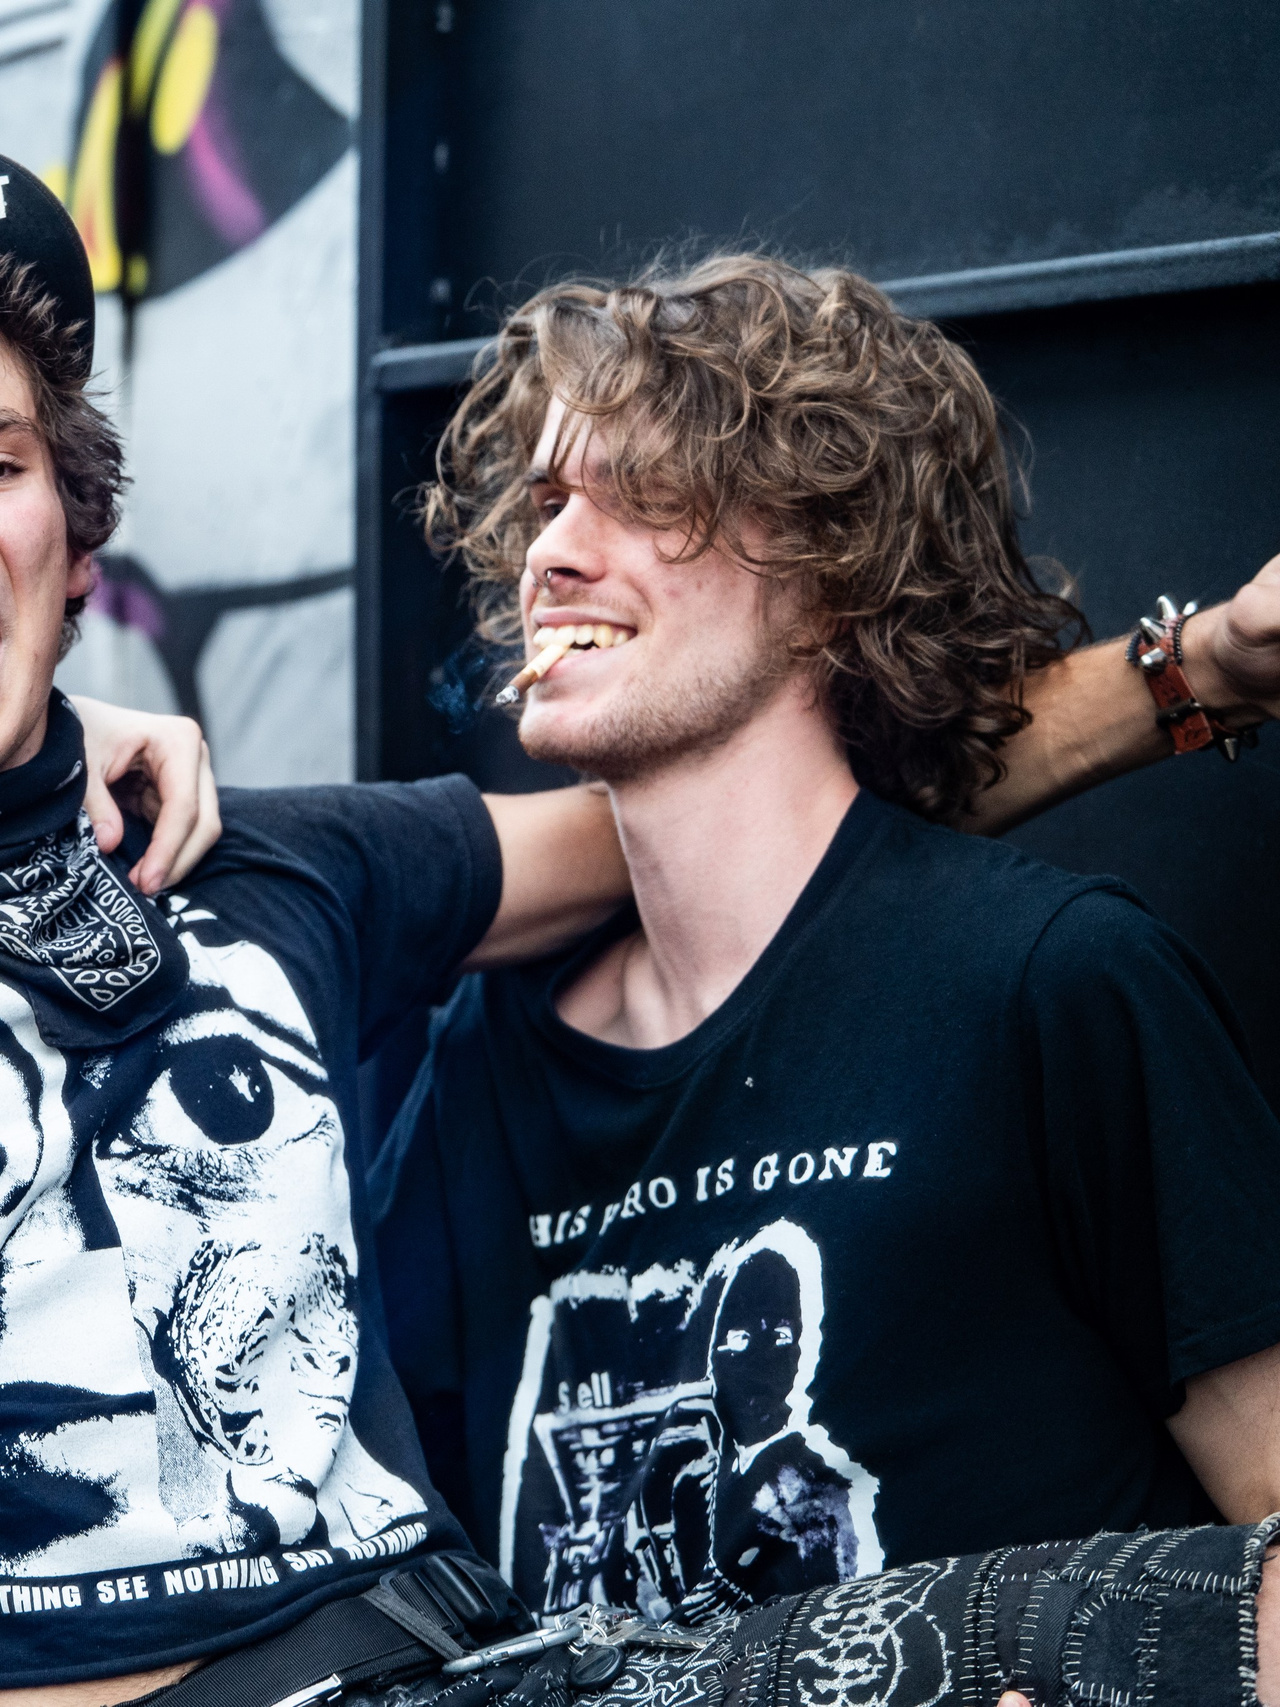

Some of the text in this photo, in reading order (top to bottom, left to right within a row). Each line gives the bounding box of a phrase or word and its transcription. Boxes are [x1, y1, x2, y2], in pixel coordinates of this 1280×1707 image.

[599, 1177, 677, 1236] RO
[696, 1158, 735, 1201] IS
[753, 1141, 897, 1191] GONE
[96, 1576, 149, 1604] SEE
[163, 1556, 279, 1596] NOTHING
[342, 1522, 428, 1561] NOTHING
